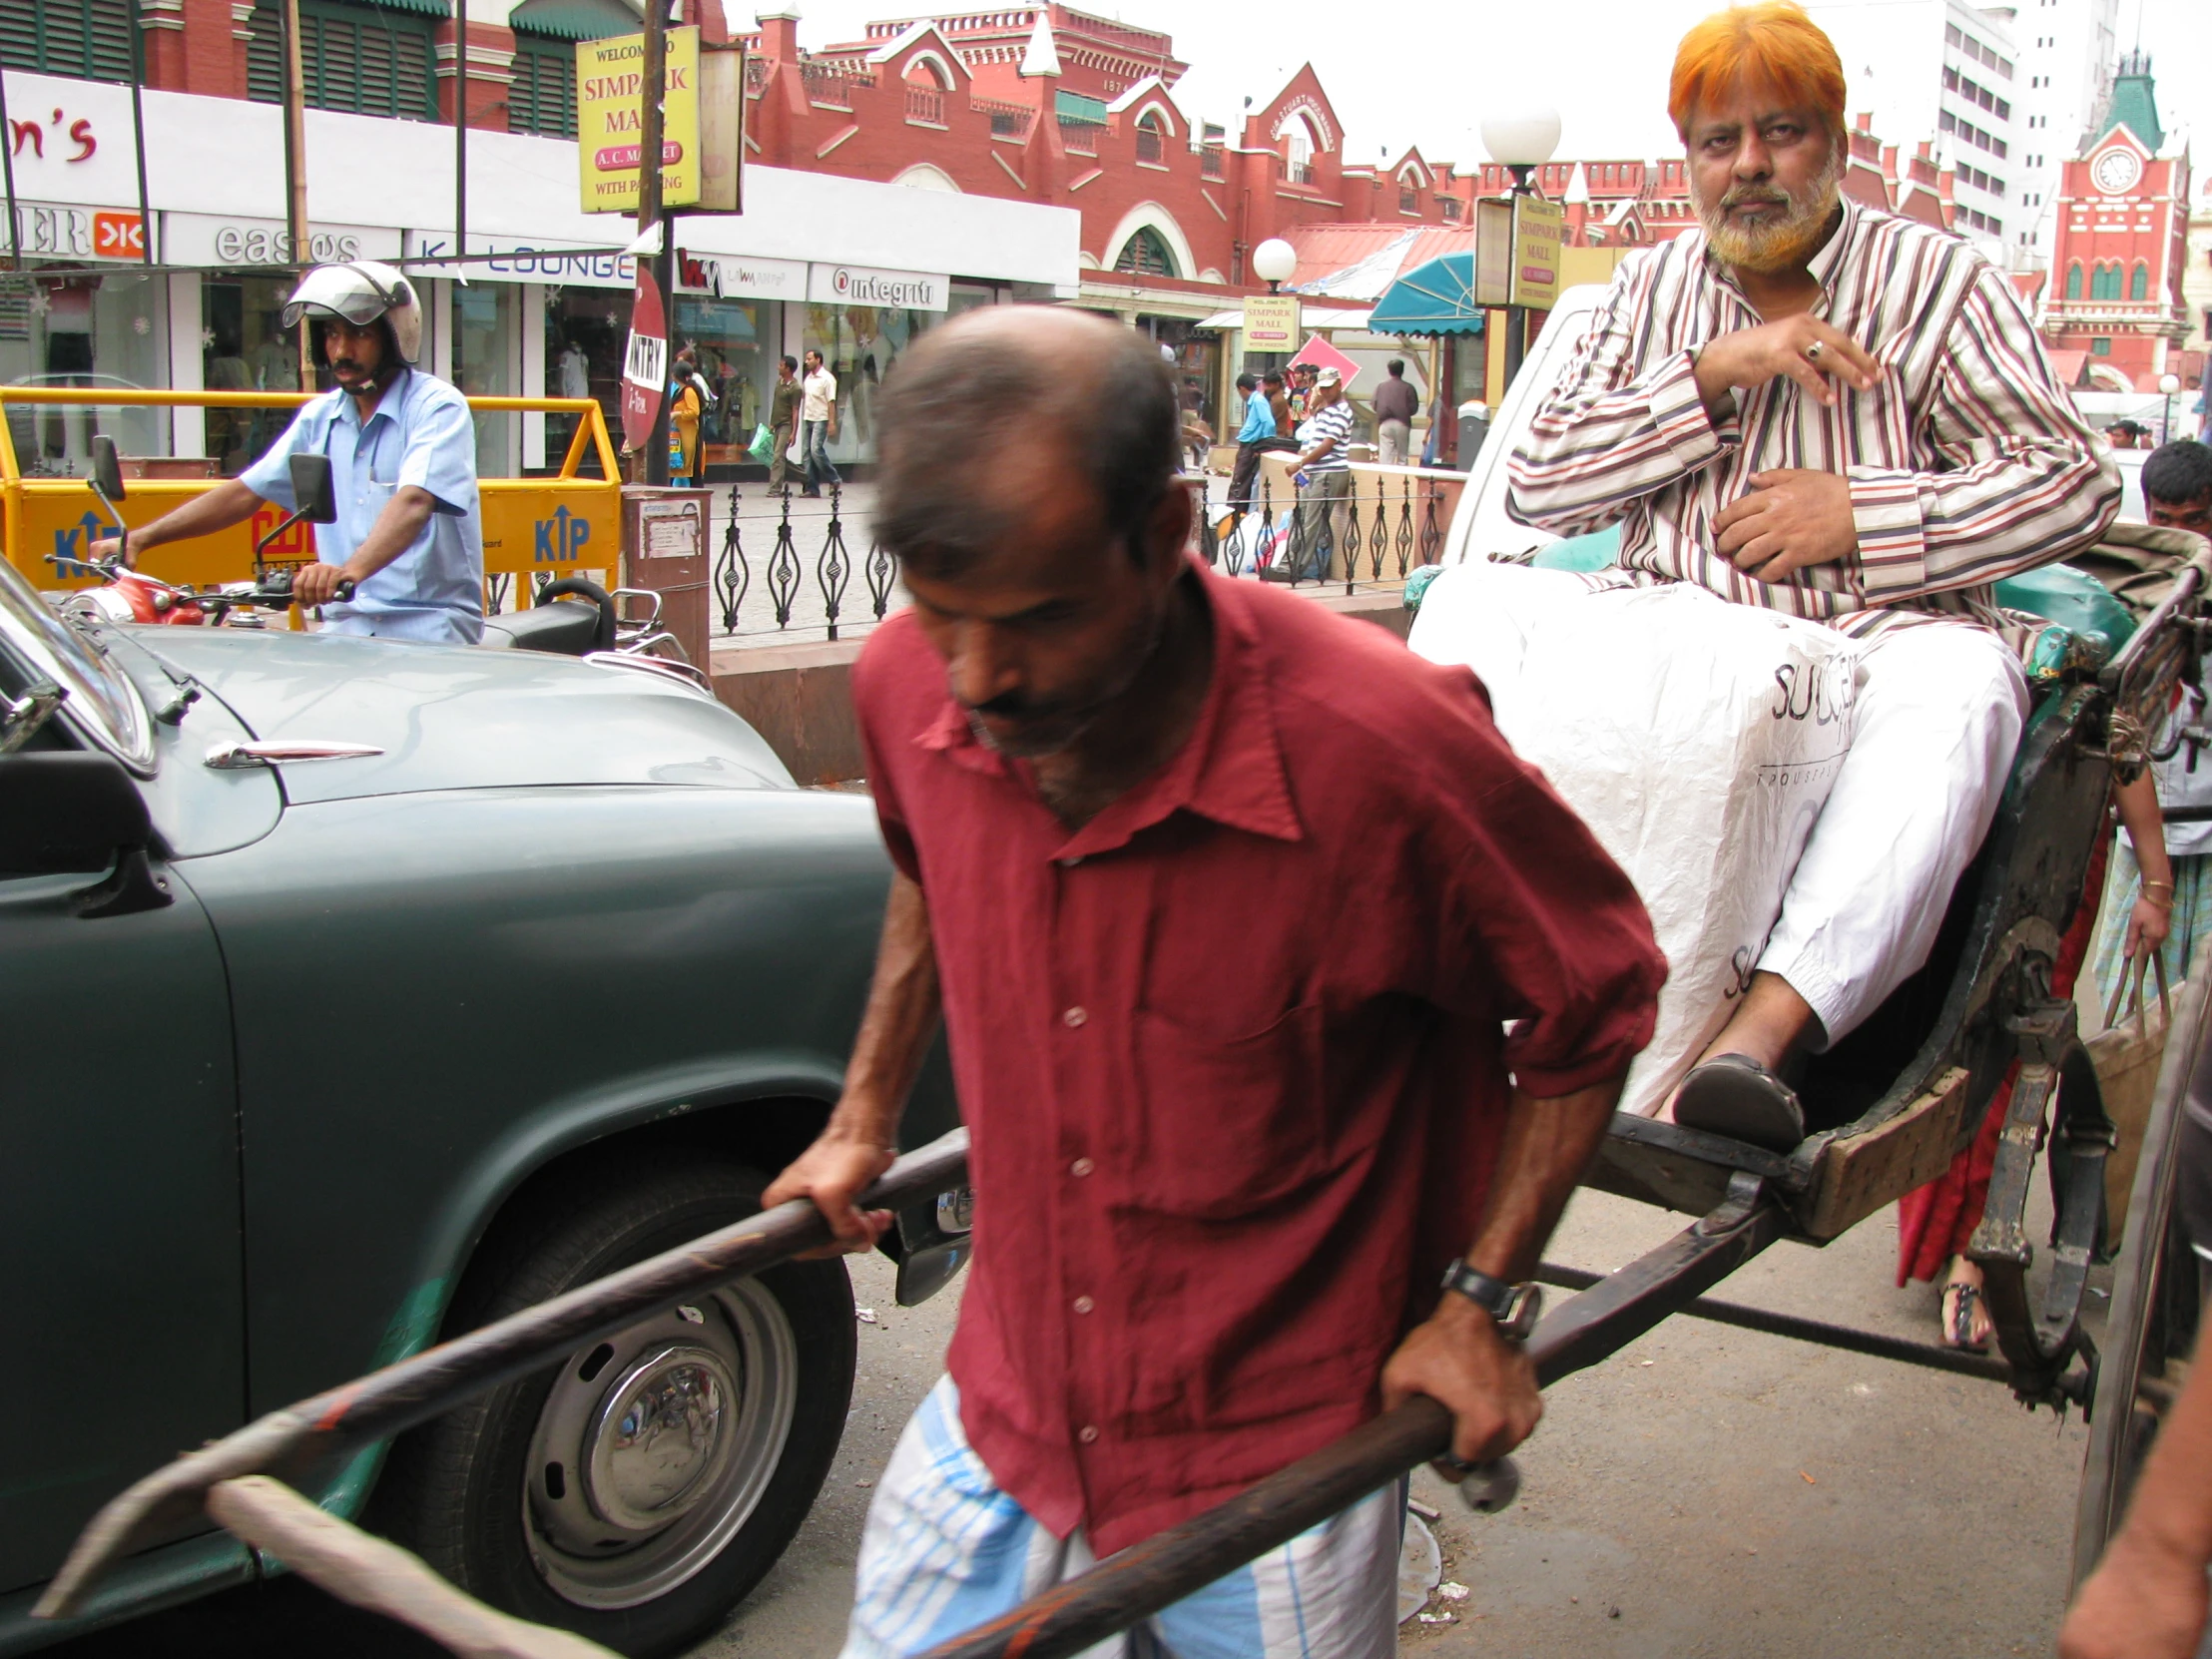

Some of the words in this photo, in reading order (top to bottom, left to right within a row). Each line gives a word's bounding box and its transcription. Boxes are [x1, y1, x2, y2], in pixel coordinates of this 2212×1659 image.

[596, 45, 645, 62] WELCOM
[584, 68, 687, 102] SIMPK
[8, 107, 97, 162] n's
[626, 145, 677, 163] MET
[596, 180, 627, 195] WITH
[1519, 221, 1558, 241] SIMPARK
[216, 227, 362, 264] eases
[1526, 244, 1551, 261] MALL
[488, 245, 635, 280] LOUNGE
[482, 539, 503, 549] uard
